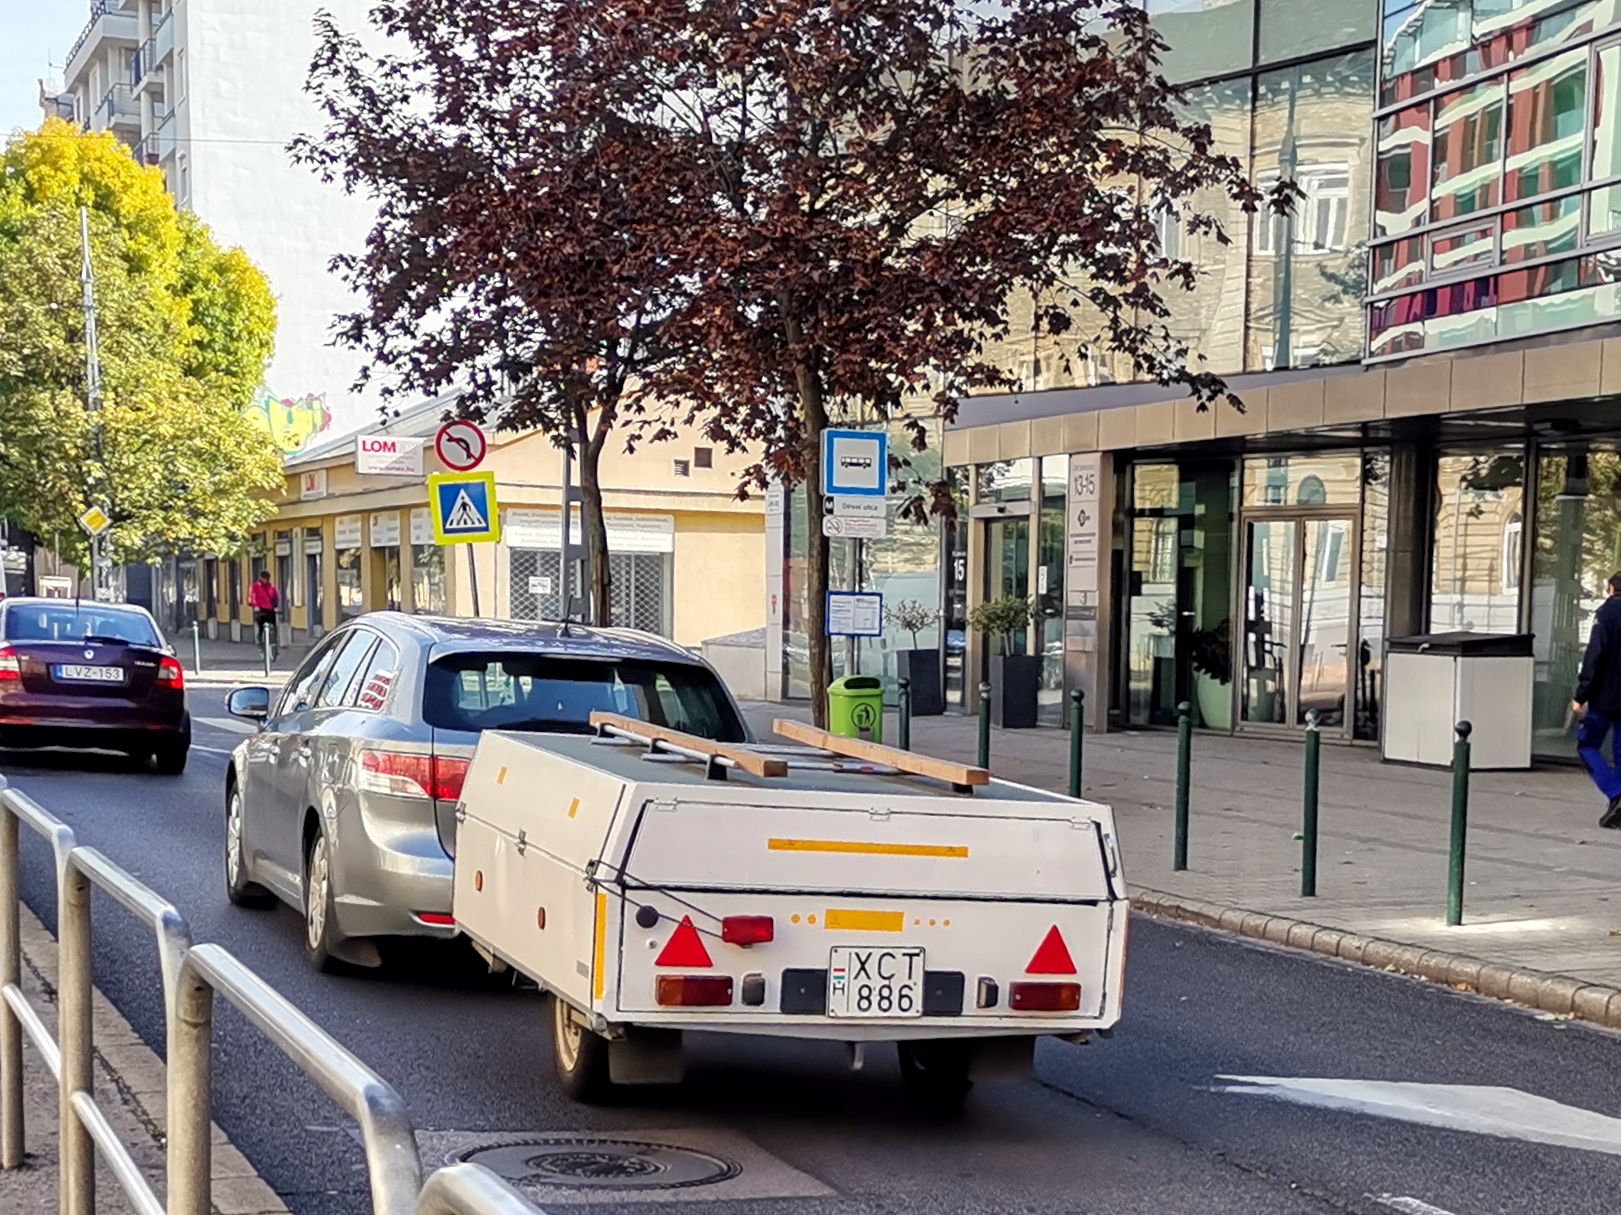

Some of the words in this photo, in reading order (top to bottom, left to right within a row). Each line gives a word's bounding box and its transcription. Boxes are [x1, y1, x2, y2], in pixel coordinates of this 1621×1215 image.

[1074, 474, 1096, 496] 13-15
[953, 559, 965, 581] 15
[65, 667, 120, 679] LVZ-153
[853, 952, 920, 981] XCT
[832, 982, 846, 996] H
[856, 984, 914, 1013] 886
